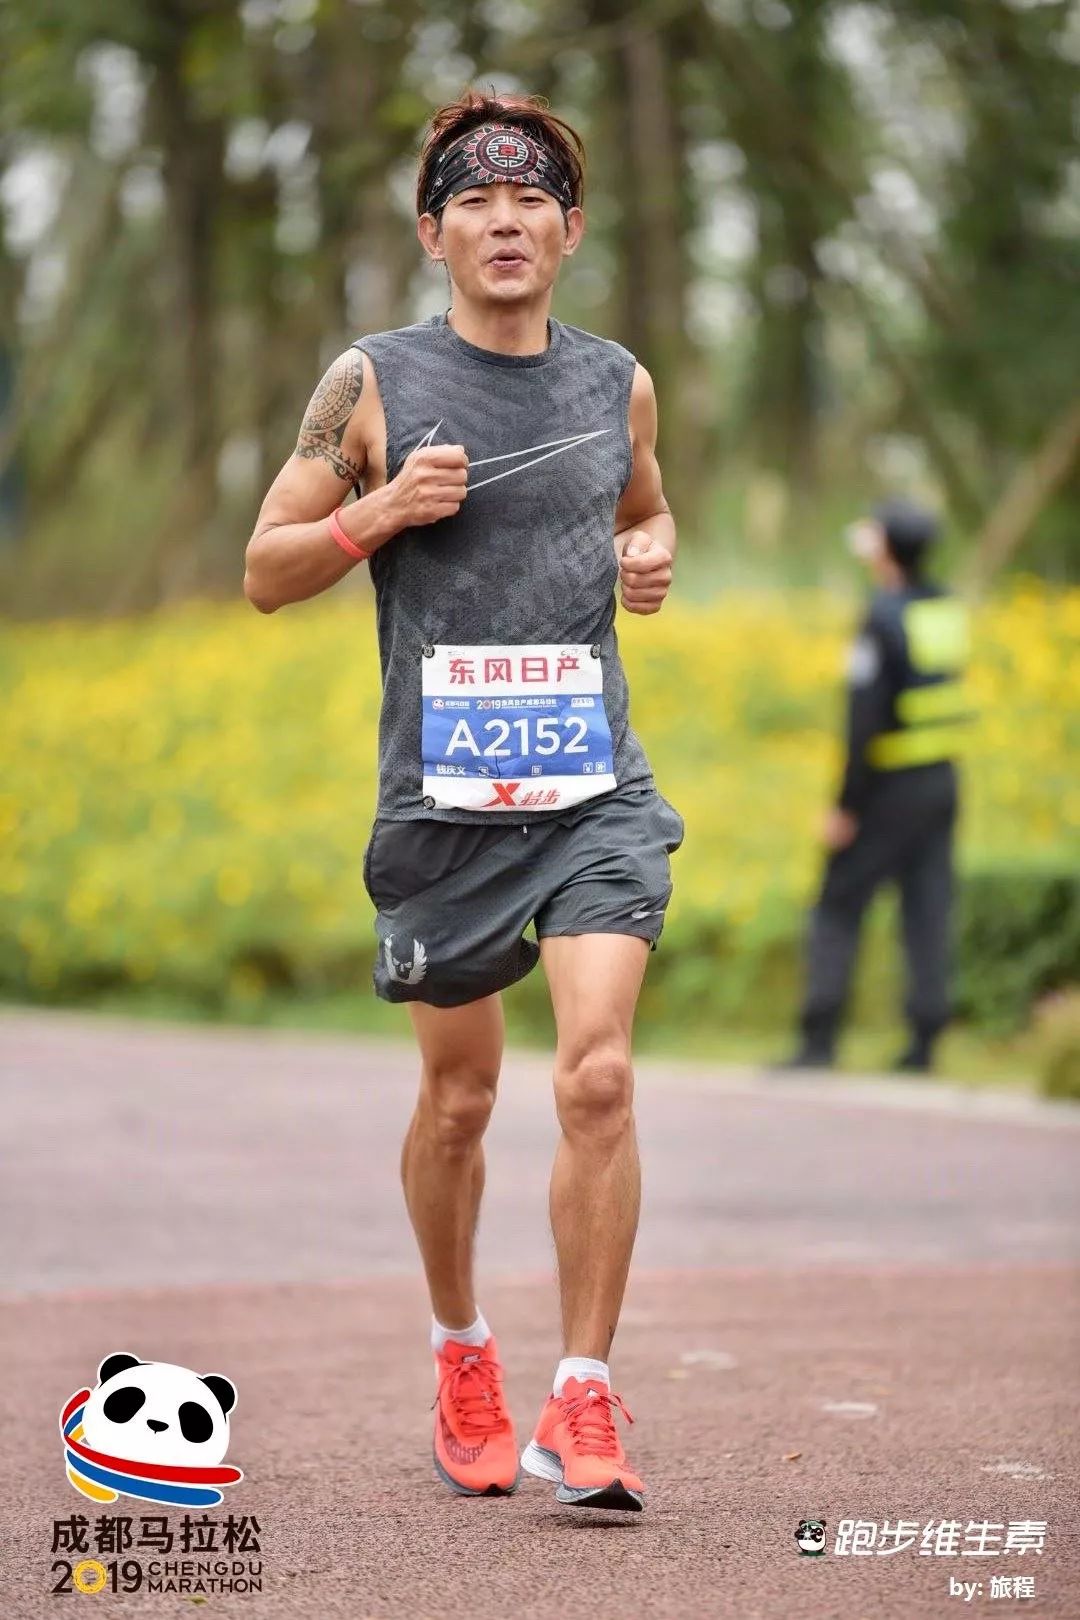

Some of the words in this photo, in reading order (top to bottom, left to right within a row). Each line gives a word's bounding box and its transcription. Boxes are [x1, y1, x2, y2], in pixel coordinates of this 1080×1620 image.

[448, 655, 580, 684] 东风日产
[445, 716, 589, 757] A2152
[520, 788, 561, 807] 特步
